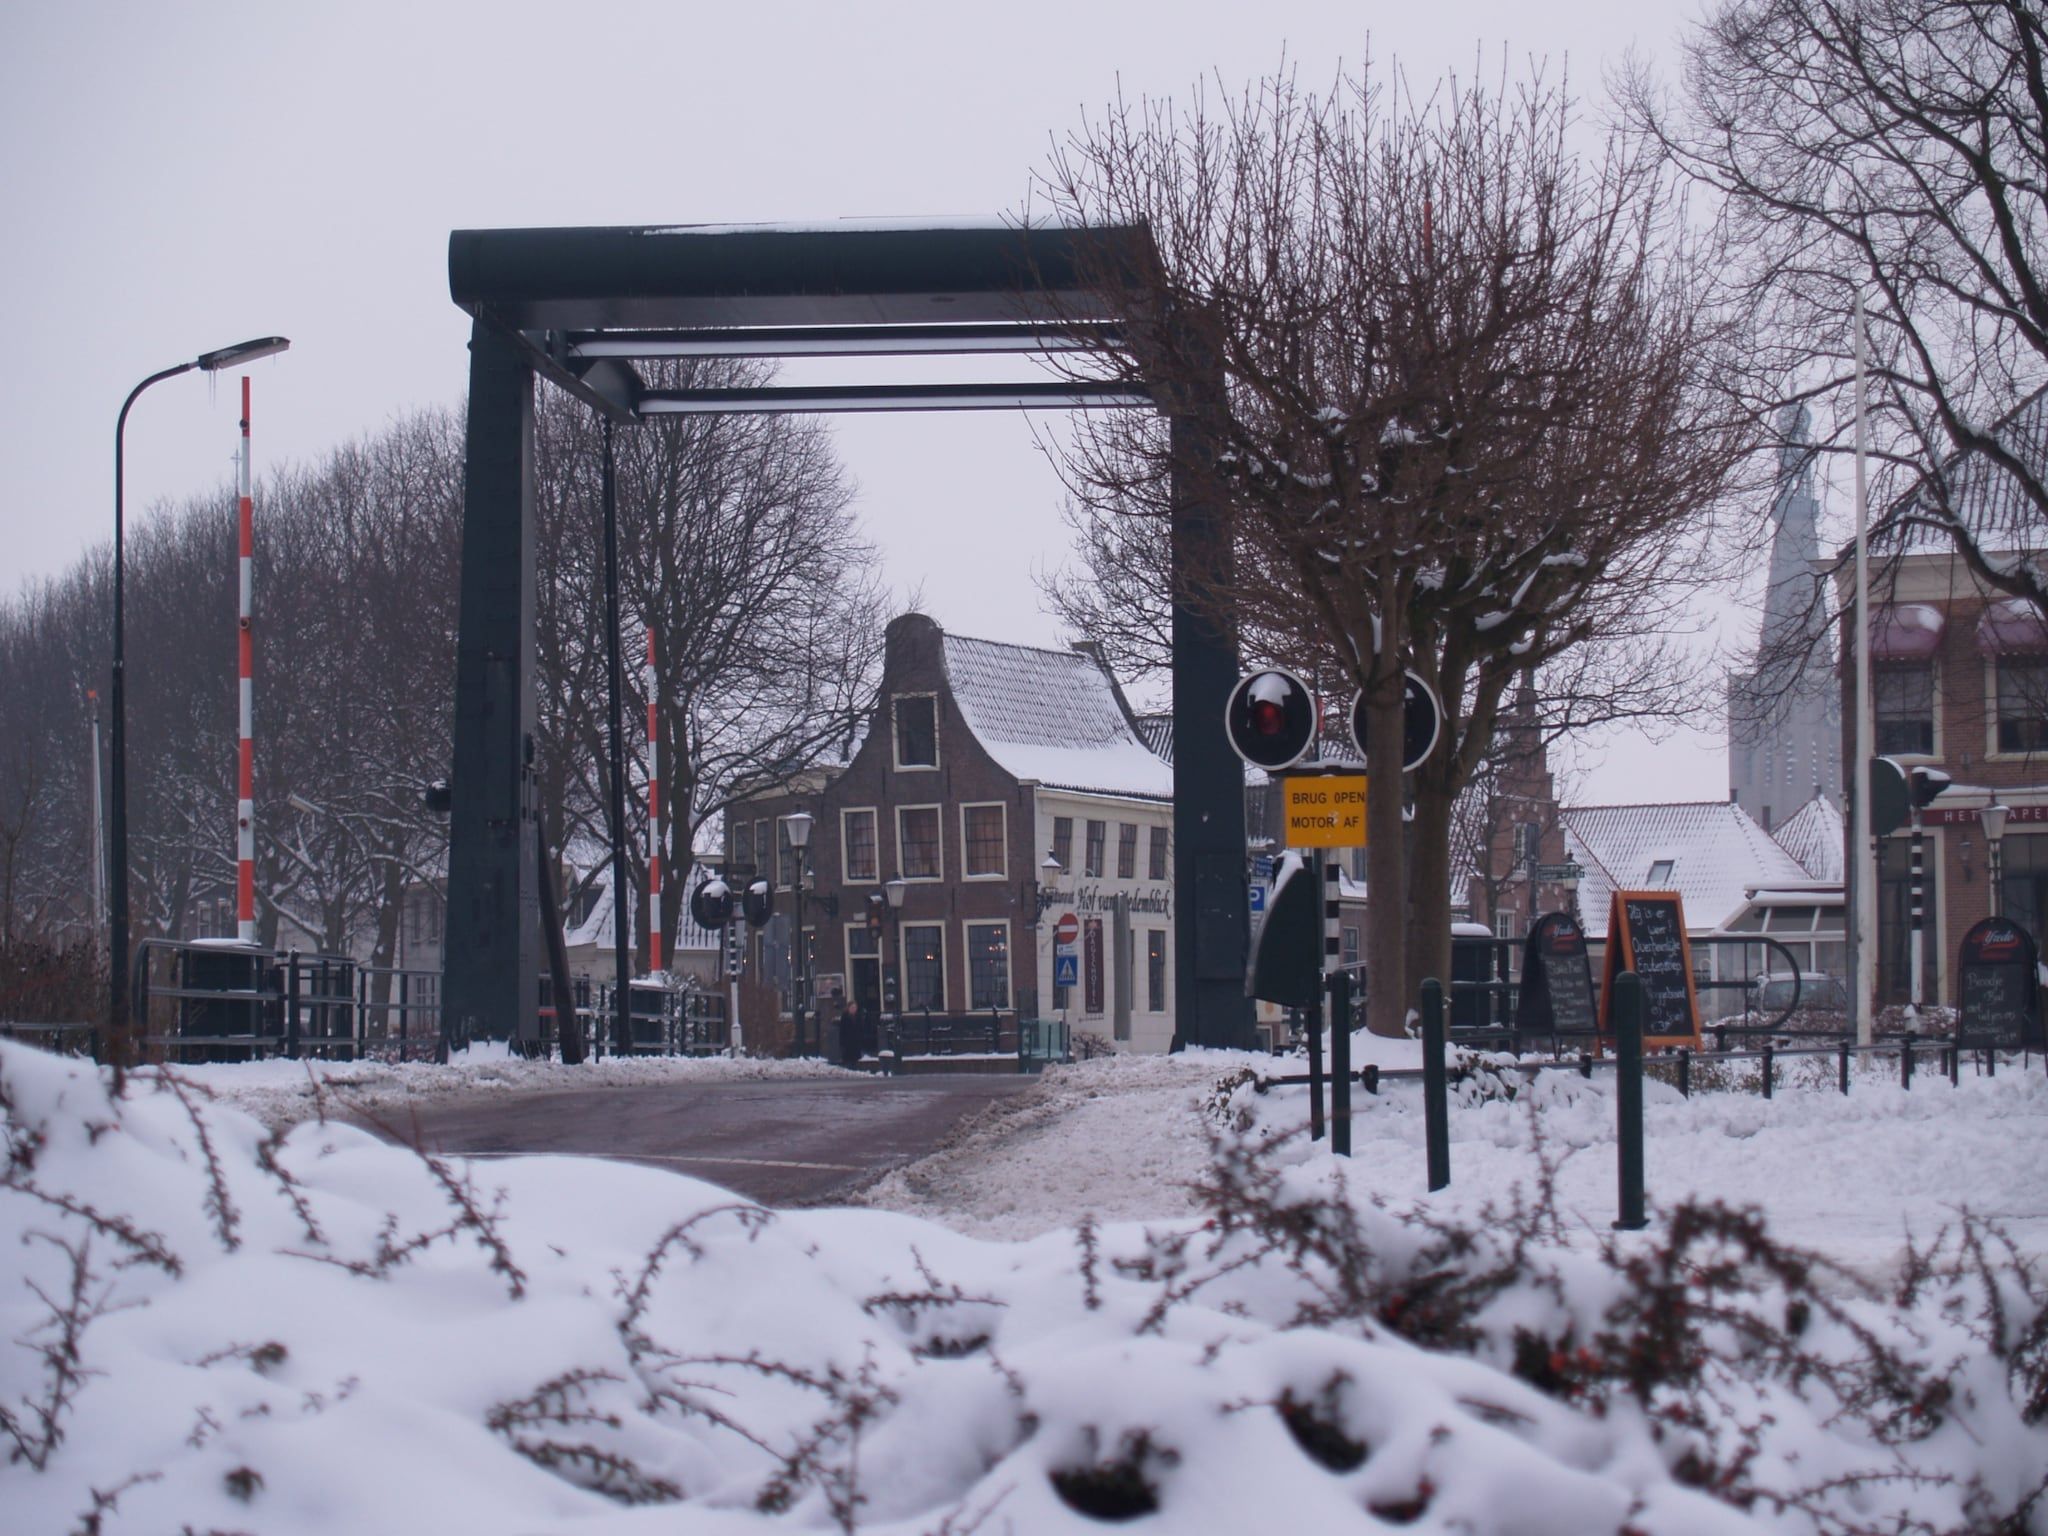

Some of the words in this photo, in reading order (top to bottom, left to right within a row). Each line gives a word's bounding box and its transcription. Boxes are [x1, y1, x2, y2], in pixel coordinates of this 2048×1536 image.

[1292, 792, 1327, 804] BRUG
[1334, 791, 1366, 804] OPEN
[1944, 810, 1978, 822] HET
[2002, 807, 2048, 820] APE
[1291, 816, 1335, 828] MOTOR
[1343, 816, 1360, 828] AF
[1119, 887, 1172, 921] edemblick
